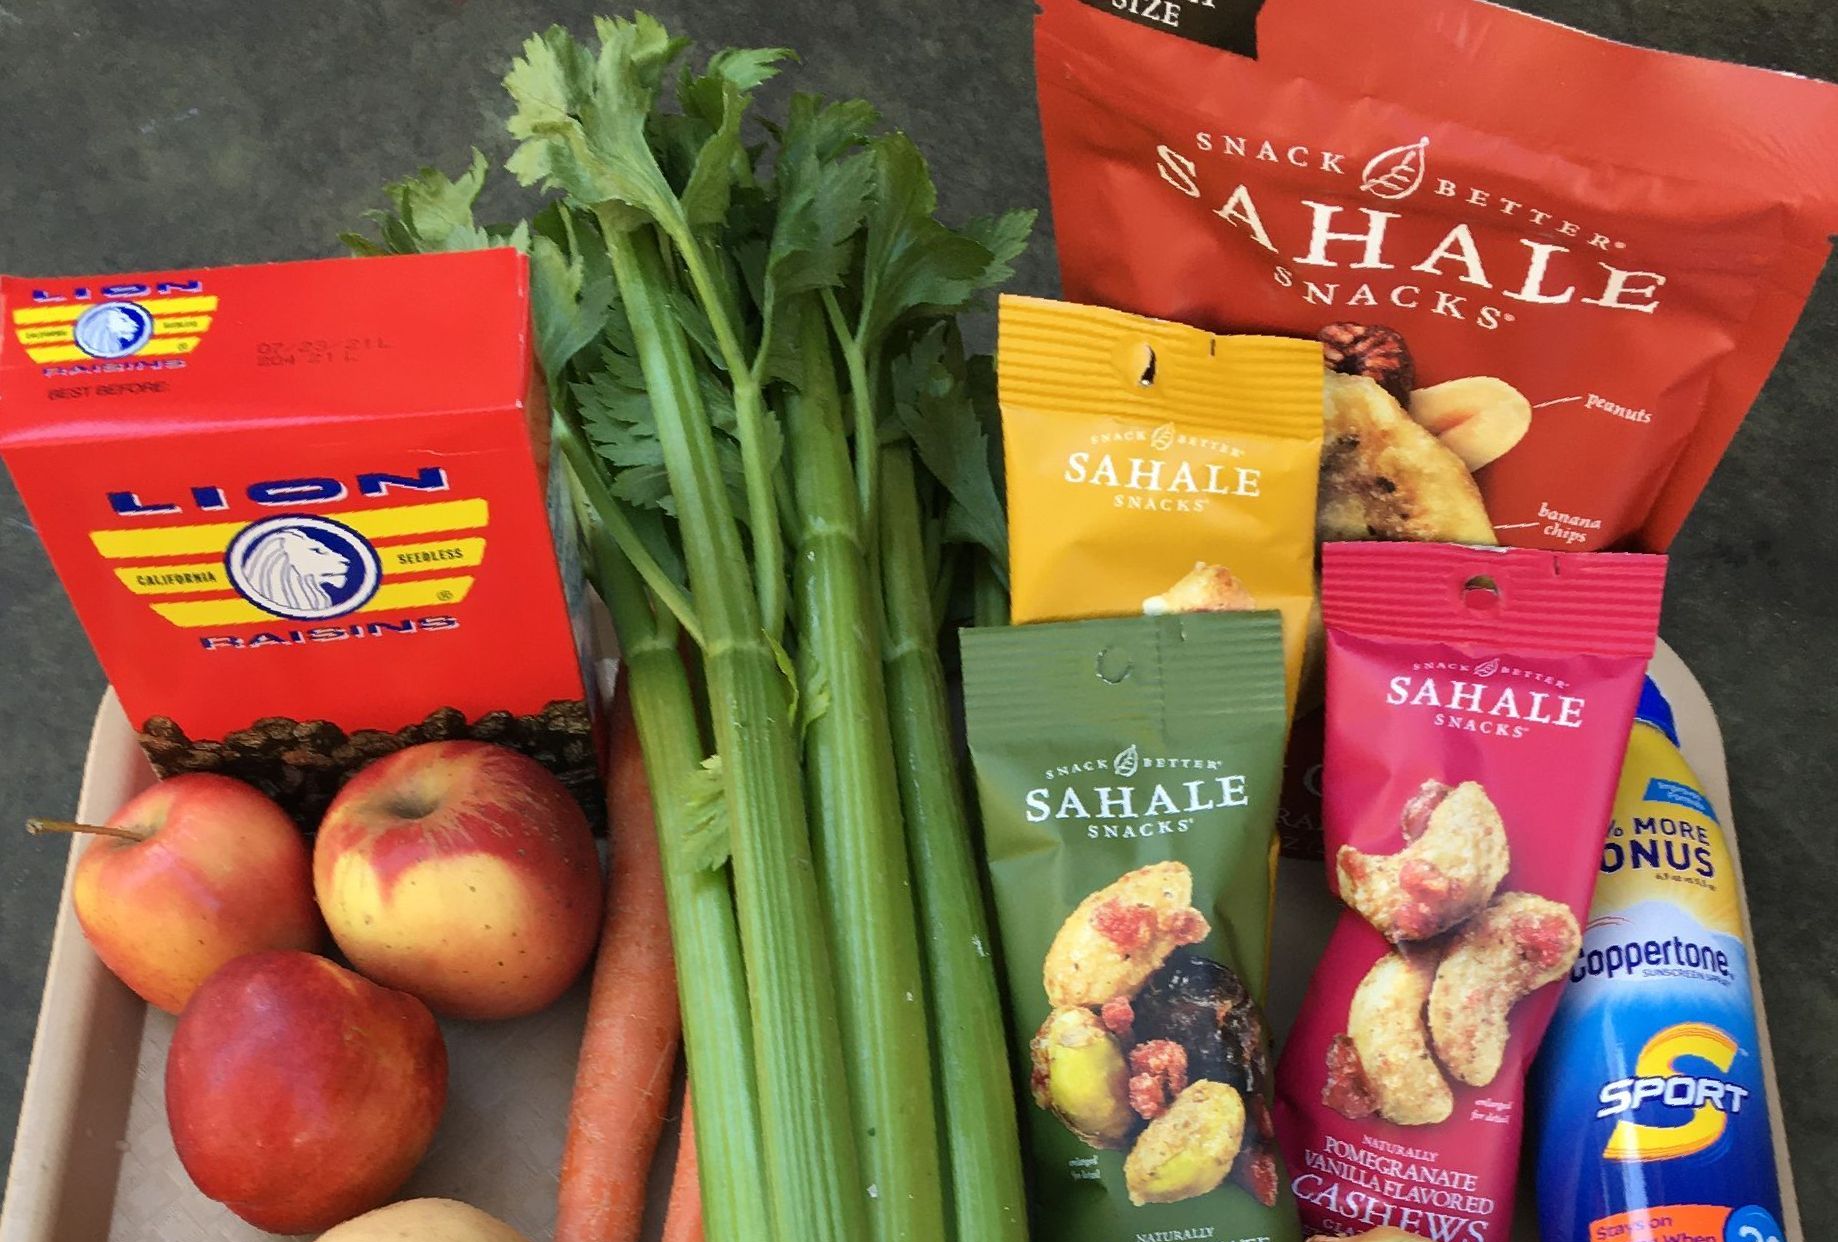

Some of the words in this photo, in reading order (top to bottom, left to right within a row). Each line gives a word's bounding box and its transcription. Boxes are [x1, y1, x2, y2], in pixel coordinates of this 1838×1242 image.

[1195, 131, 1346, 175] SNACK
[1436, 178, 1611, 251] BETTER
[1156, 144, 1667, 315] SAHALE
[32, 280, 203, 302] LION
[1273, 265, 1505, 331] SNACKS
[43, 359, 187, 377] RAISINS
[48, 386, 90, 400] BEST
[96, 381, 169, 396] BEFORE
[1584, 393, 1652, 424] peanuts
[1090, 430, 1146, 445] SNACK
[1177, 435, 1242, 458] BETTER
[1064, 452, 1261, 497] SAHALE
[107, 466, 450, 516] LION
[1114, 494, 1206, 512] SNACKS
[1538, 502, 1602, 530] banana
[1544, 523, 1587, 544] chips
[397, 547, 465, 566] SEEDLESS
[137, 569, 217, 587] CALIFORNIA
[200, 615, 461, 651] RAISINS
[1413, 662, 1470, 672] SNACK
[1500, 666, 1566, 689] BETTER
[1386, 676, 1586, 728] SAHALE
[1434, 713, 1524, 738] SNACKS
[1046, 758, 1108, 780] SNACK
[1143, 757, 1219, 770] BETTER
[1025, 775, 1249, 823] SAHALE
[1087, 818, 1190, 839] SNACKS
[1633, 817, 1711, 847] MORE
[1600, 839, 1715, 878] ONUS
[1569, 936, 1730, 983] Coppertone
[1597, 1076, 1749, 1119] SPORT
[1362, 1134, 1439, 1162] NATURALLY
[1323, 1136, 1479, 1192] POMEGRANATE
[1304, 1149, 1381, 1193] VANILLA
[1384, 1178, 1495, 1216] FLAVORED
[1650, 1214, 1673, 1230] on
